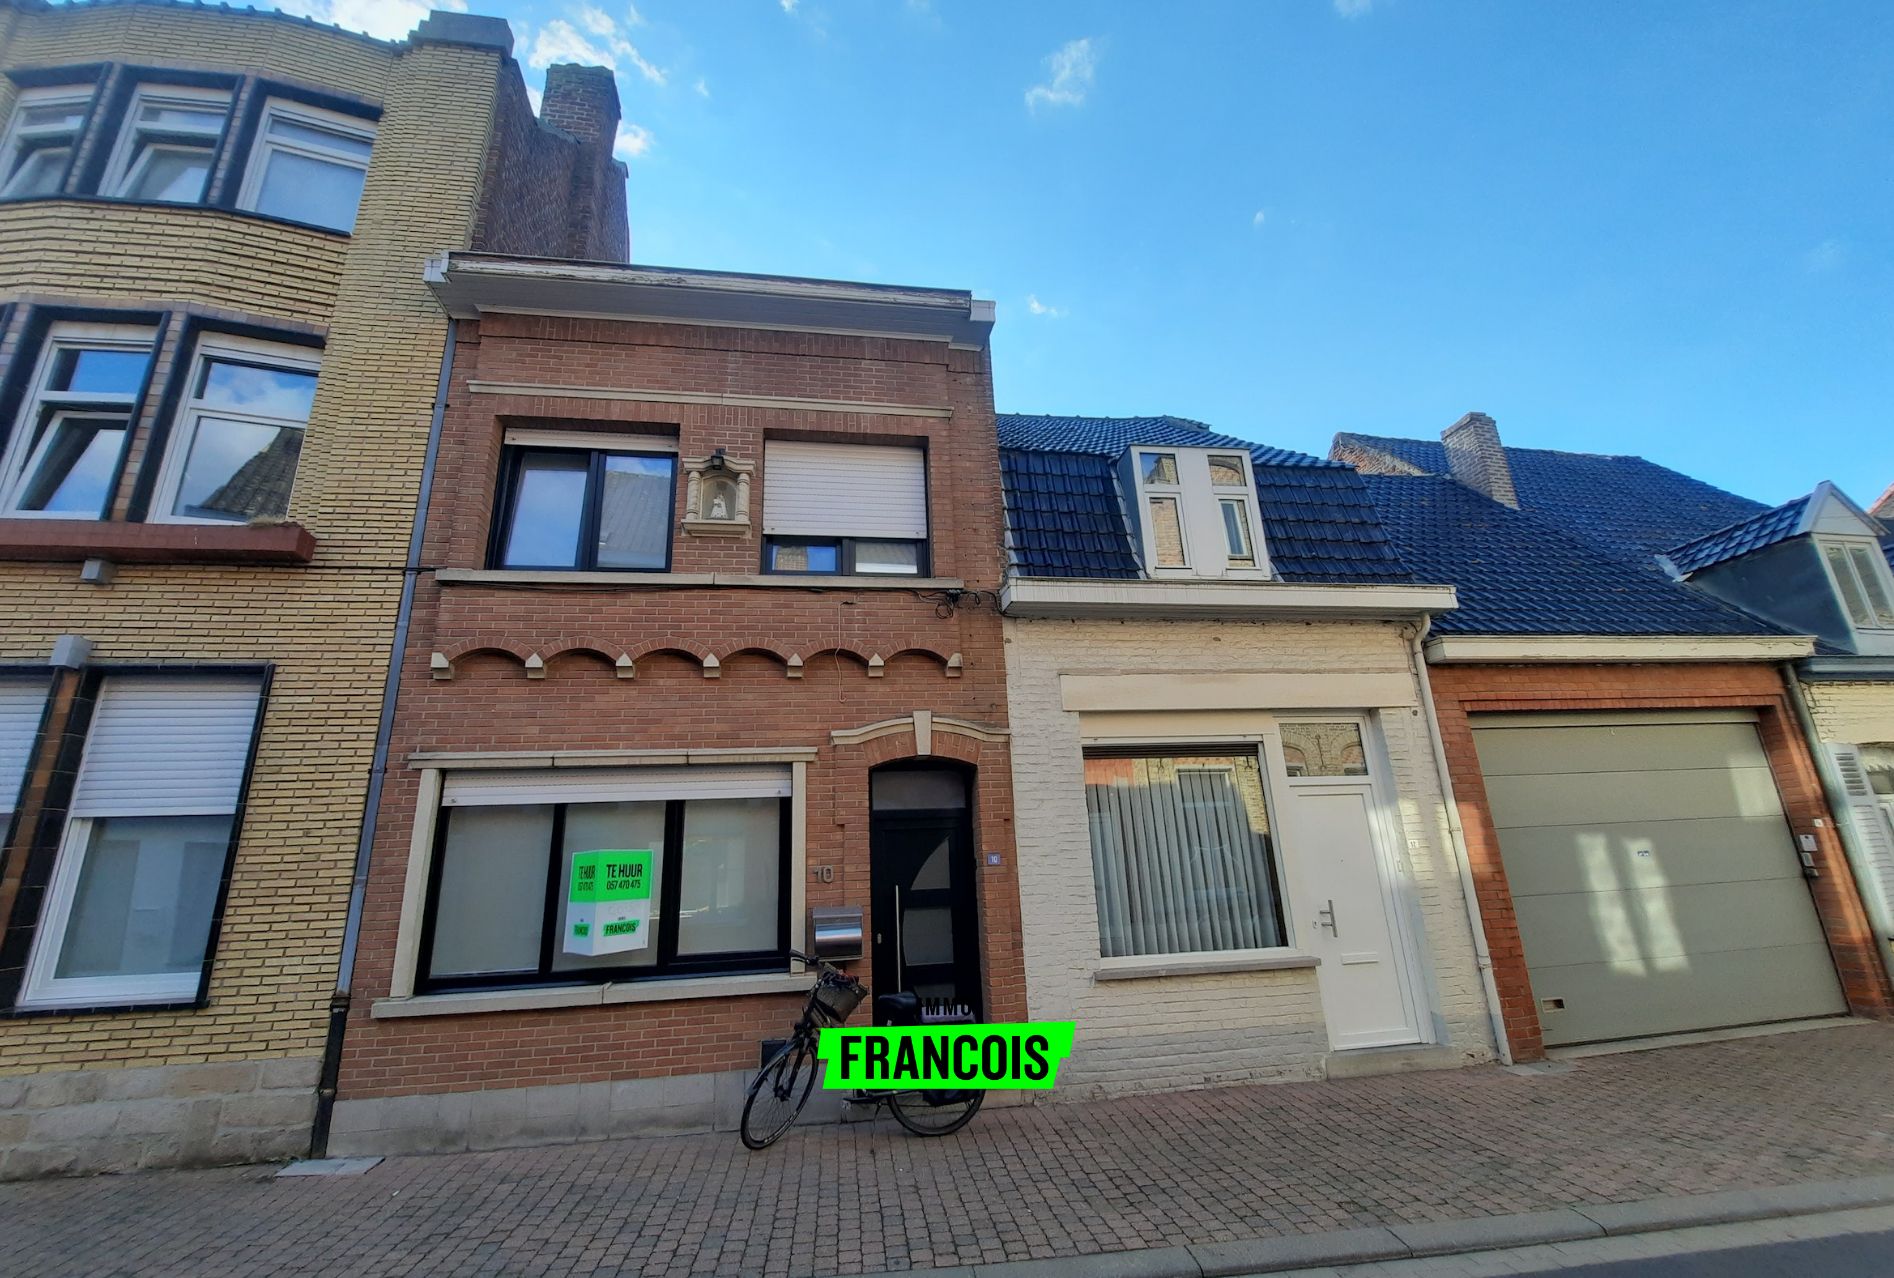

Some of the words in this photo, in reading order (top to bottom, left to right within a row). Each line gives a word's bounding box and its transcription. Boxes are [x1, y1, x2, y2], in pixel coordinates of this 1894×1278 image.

[991, 855, 998, 863] 10
[606, 864, 617, 878] TE
[618, 863, 643, 878] HUUR
[814, 865, 833, 883] 10
[606, 880, 618, 890] 057
[618, 880, 630, 889] 470
[630, 879, 641, 889] 475
[605, 922, 637, 935] FRANCOIS
